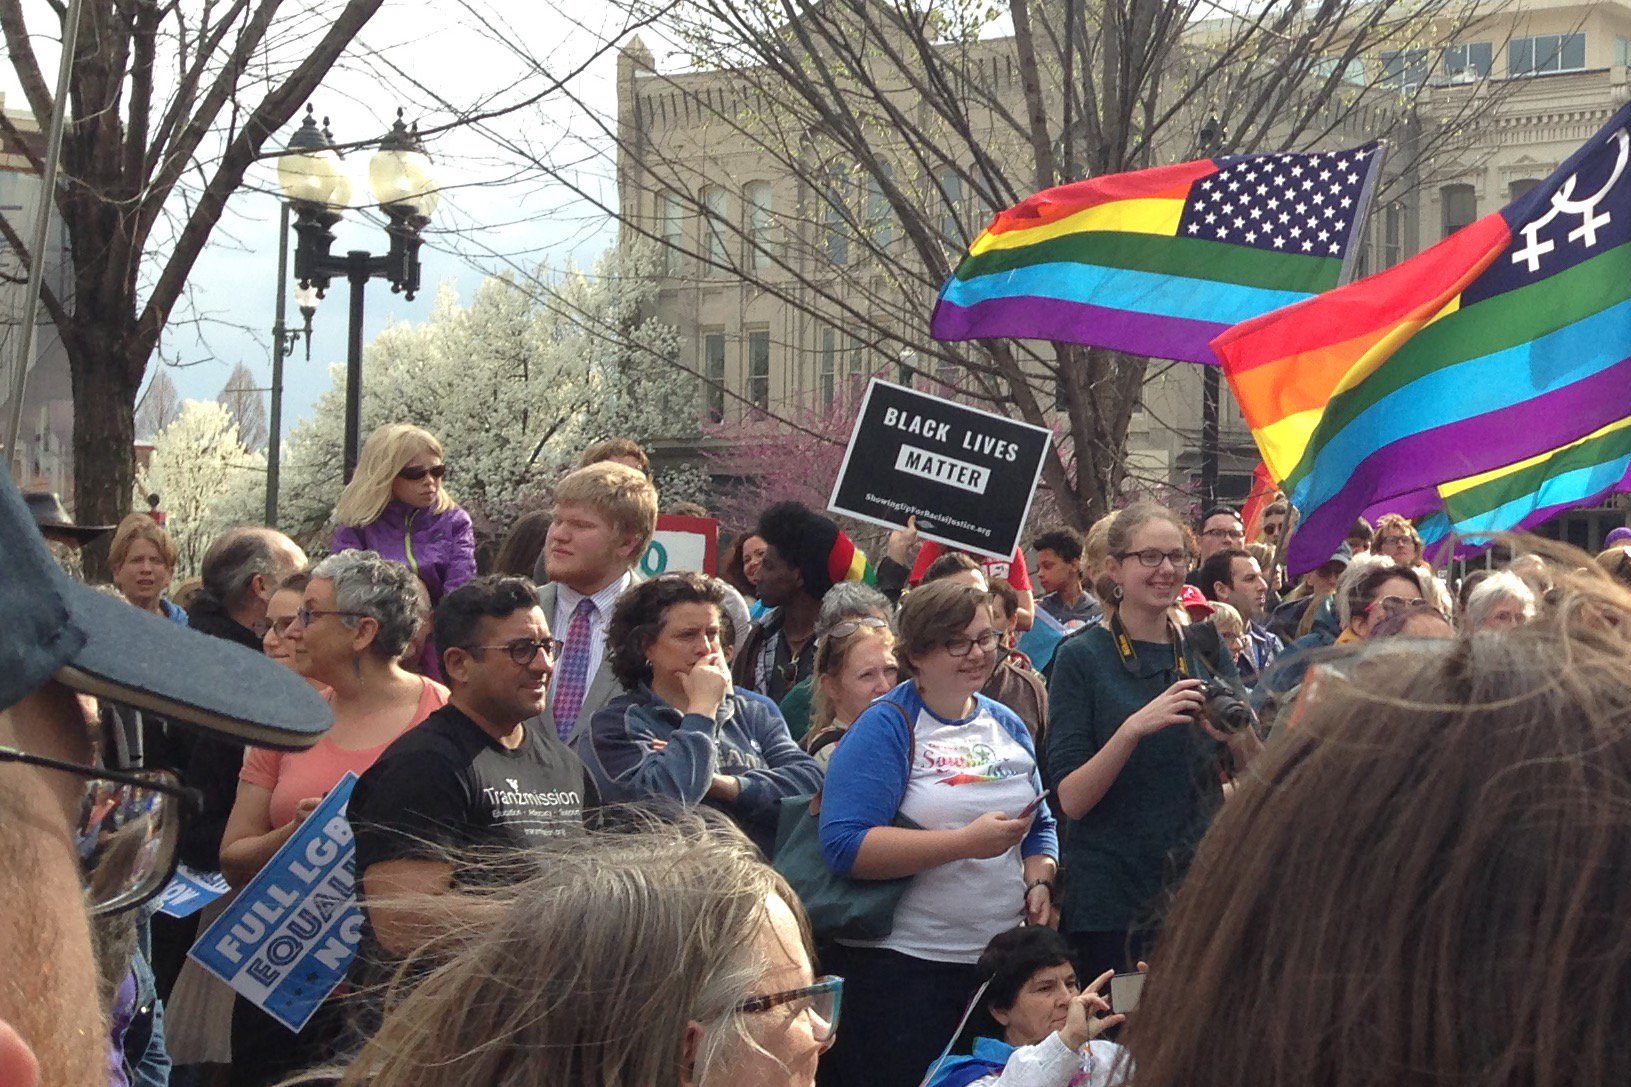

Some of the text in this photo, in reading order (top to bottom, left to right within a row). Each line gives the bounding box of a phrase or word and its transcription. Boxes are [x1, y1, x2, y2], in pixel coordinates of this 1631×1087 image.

[884, 407, 1019, 462] BLACK LIVES
[904, 450, 982, 488] MATTER
[865, 493, 992, 537] ShowingUpForRacialJustice.org
[483, 786, 580, 805] Tranzmission
[215, 801, 354, 964] FULL LGB
